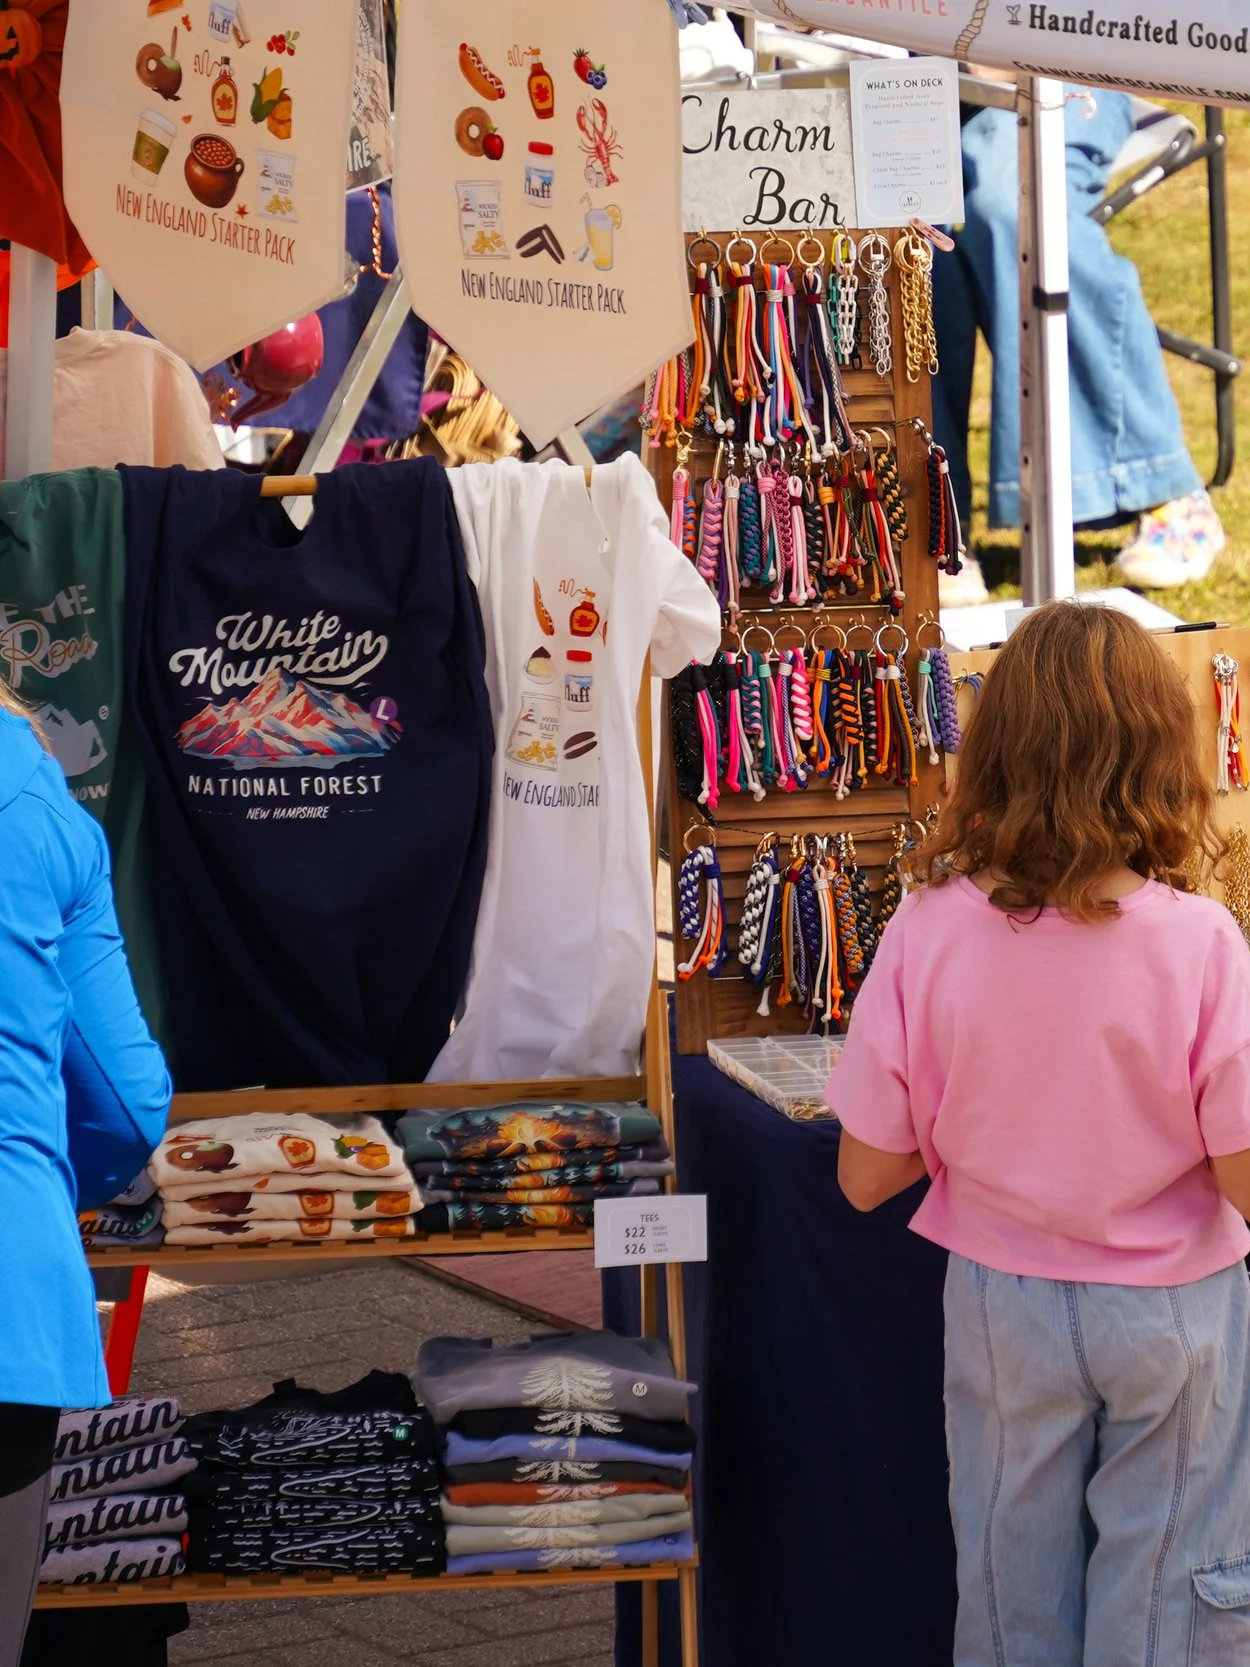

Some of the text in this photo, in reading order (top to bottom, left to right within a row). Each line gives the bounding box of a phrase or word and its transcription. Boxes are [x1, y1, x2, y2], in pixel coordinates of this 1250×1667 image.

[1029, 3, 1178, 45] Handcrafted
[866, 78, 943, 90] WHAT'S ON DECK
[681, 94, 835, 154] Charm
[743, 166, 845, 227] Bar
[116, 184, 296, 265] NEW ENGLAND STARTER PACK
[461, 268, 626, 314] NEW ENGLAND STARTER PACK
[32, 584, 96, 624] THE
[216, 610, 342, 651] White
[168, 630, 388, 695] Mountain
[376, 699, 389, 720] L
[188, 775, 382, 797] NATIONAL FOREST
[525, 780, 576, 807] ENGLAND
[246, 806, 329, 819] NEW HAMPSHIRE
[624, 1227, 645, 1238] $22
[640, 1214, 659, 1222] TEES
[624, 1243, 646, 1255] $26
